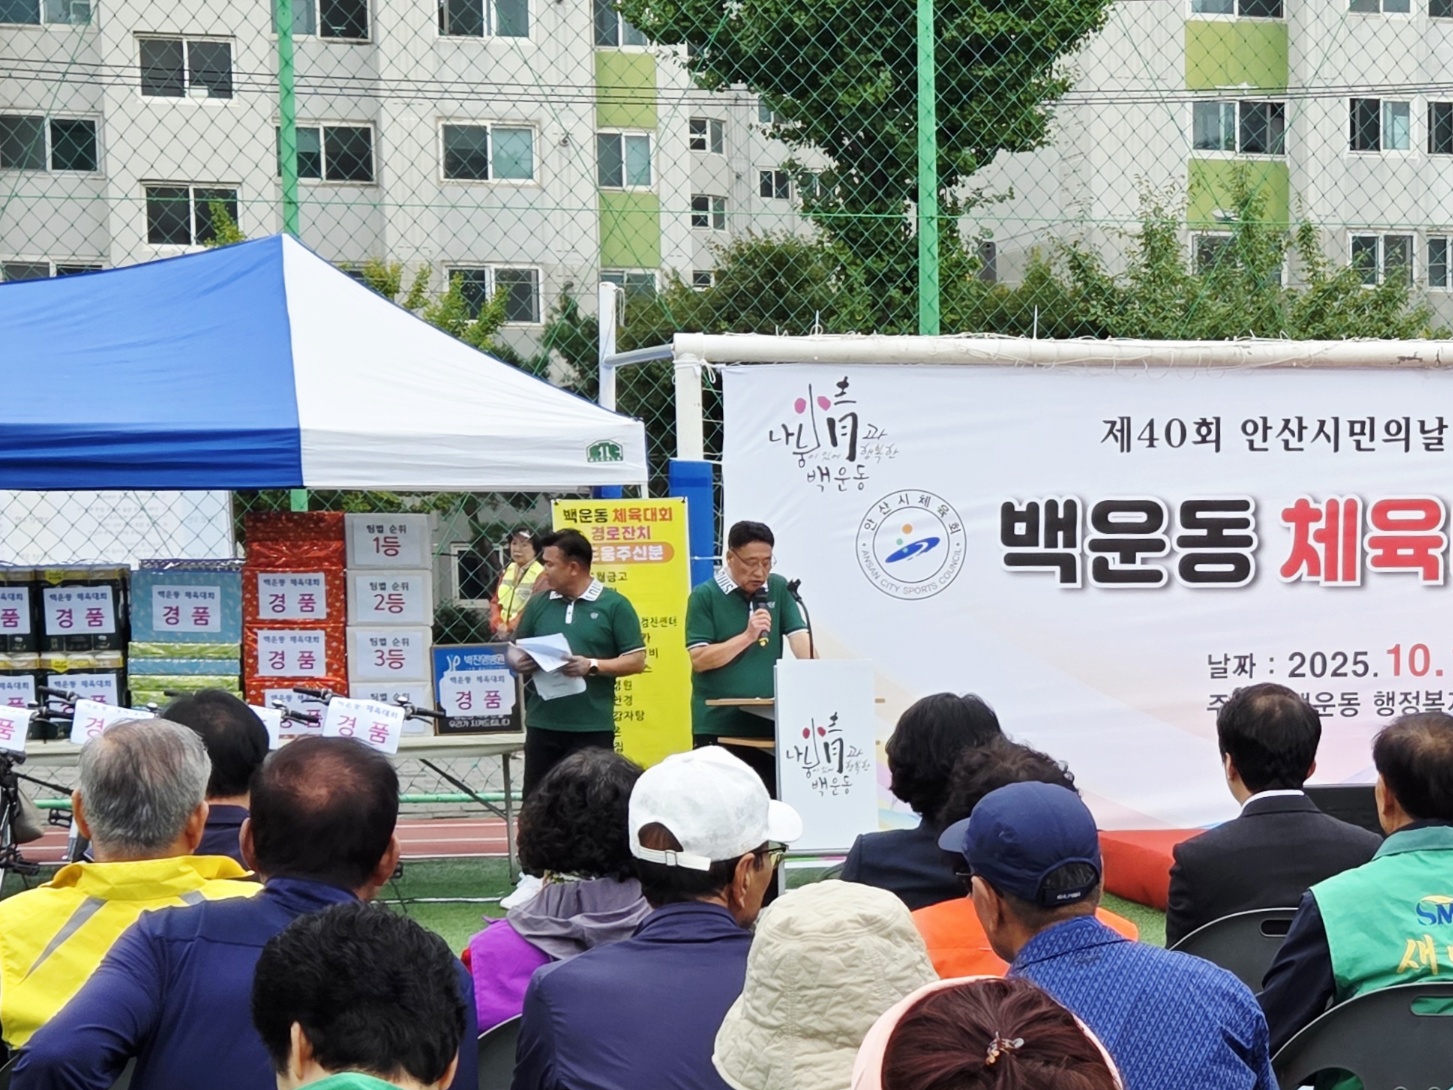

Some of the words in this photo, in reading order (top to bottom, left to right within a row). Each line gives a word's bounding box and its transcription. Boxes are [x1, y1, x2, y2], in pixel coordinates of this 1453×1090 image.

[1100, 416, 1222, 453] 제40회
[1240, 416, 1449, 453] 안산시민의날
[807, 465, 870, 492] 백운동
[563, 508, 609, 523] 백운동
[612, 507, 673, 523] 체육대회
[591, 525, 652, 541] 경로잔치
[998, 496, 1257, 588] 백운동
[373, 536, 402, 557] 1등
[861, 549, 881, 580] ANSAN
[880, 578, 901, 593] CITY
[903, 583, 938, 595] SPORTS
[939, 548, 962, 585] COUNCIL
[374, 594, 405, 614] 2등
[374, 650, 406, 669] 3등
[1206, 652, 1257, 680] 날짜
[811, 775, 853, 797] 백운동
